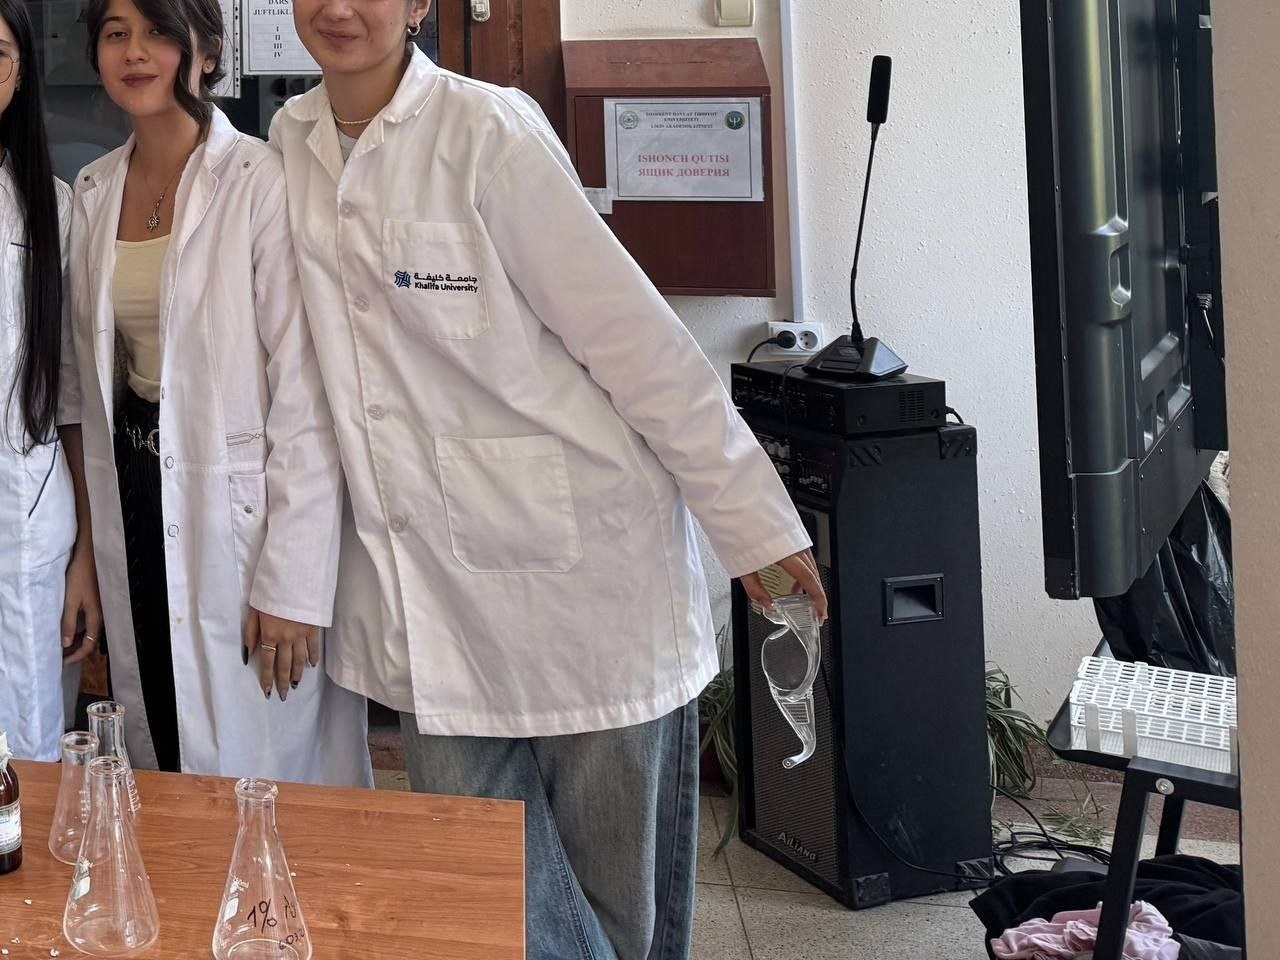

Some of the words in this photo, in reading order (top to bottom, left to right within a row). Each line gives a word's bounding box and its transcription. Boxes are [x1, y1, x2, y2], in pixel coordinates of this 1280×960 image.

[253, 8, 292, 16] JUFTLIKL
[638, 154, 688, 163] ISHONCH
[691, 154, 729, 164] QUTISI
[638, 167, 673, 177] ЯЩИК
[676, 167, 730, 177] ДОВЕРИЯ
[414, 281, 440, 290] Khalifa
[440, 283, 478, 293] University
[247, 898, 278, 934] 1%
